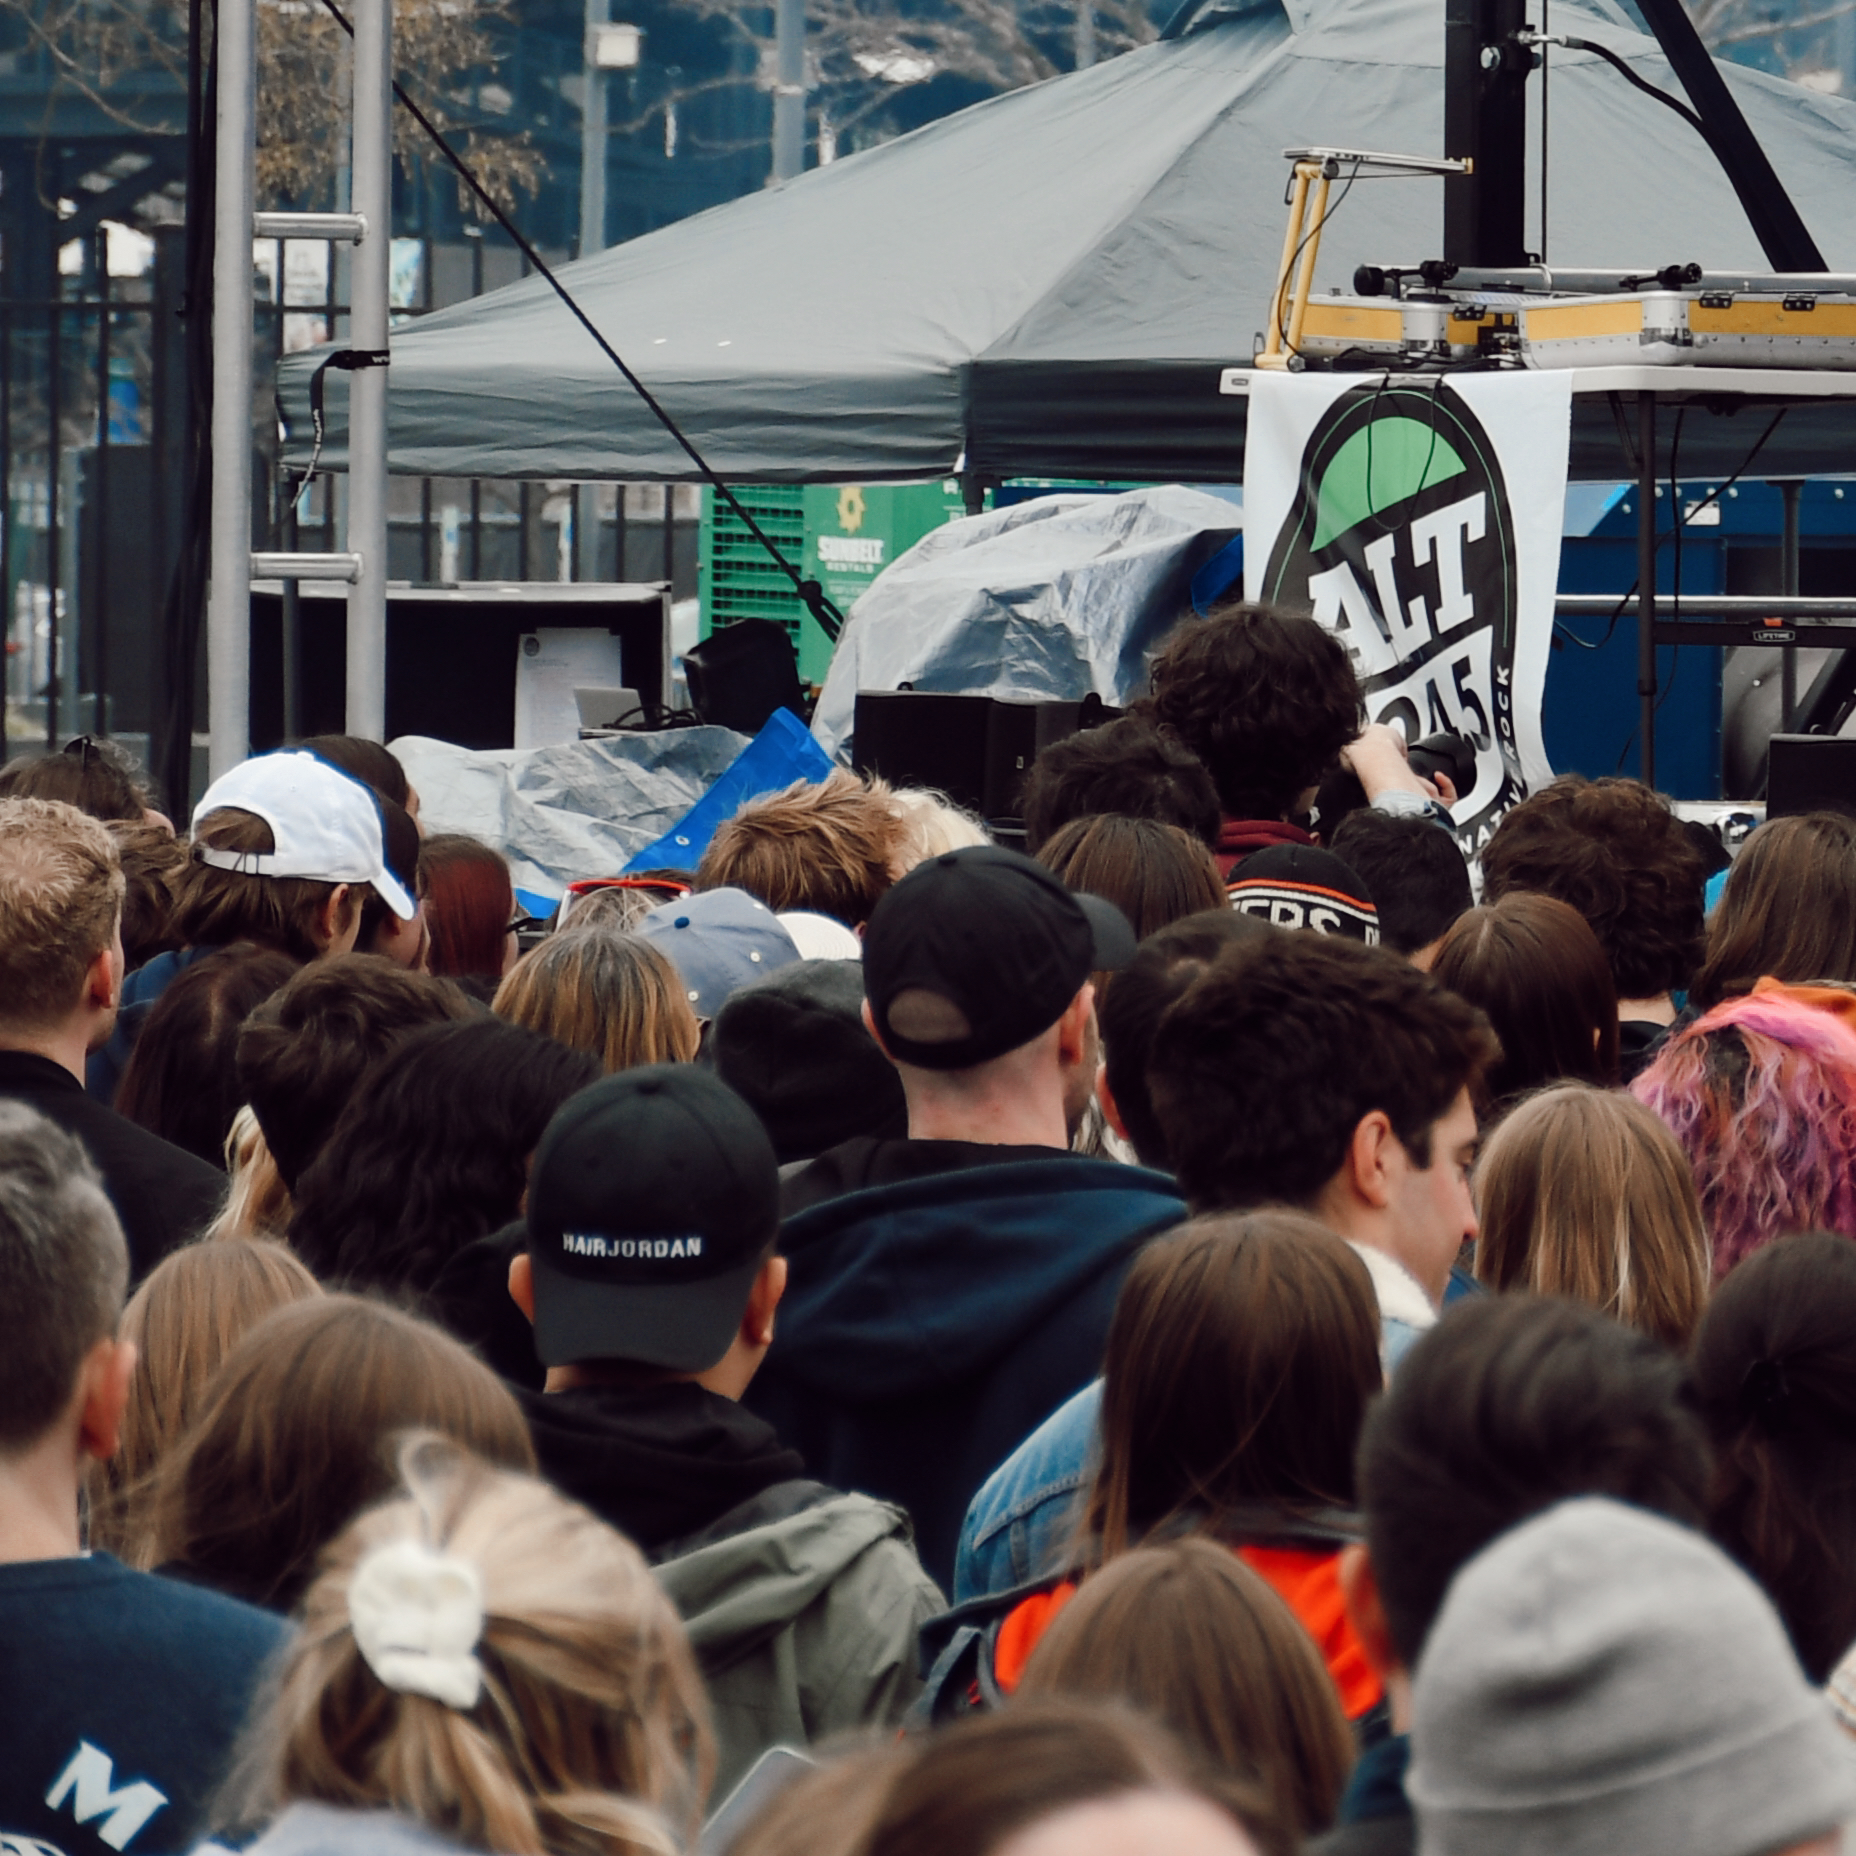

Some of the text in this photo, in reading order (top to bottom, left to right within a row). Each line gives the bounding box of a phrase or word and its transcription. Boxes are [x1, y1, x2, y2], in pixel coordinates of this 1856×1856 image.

[1308, 491, 1486, 677] ALT
[1496, 664, 1517, 762] ROCK
[44, 1738, 170, 1853] M
